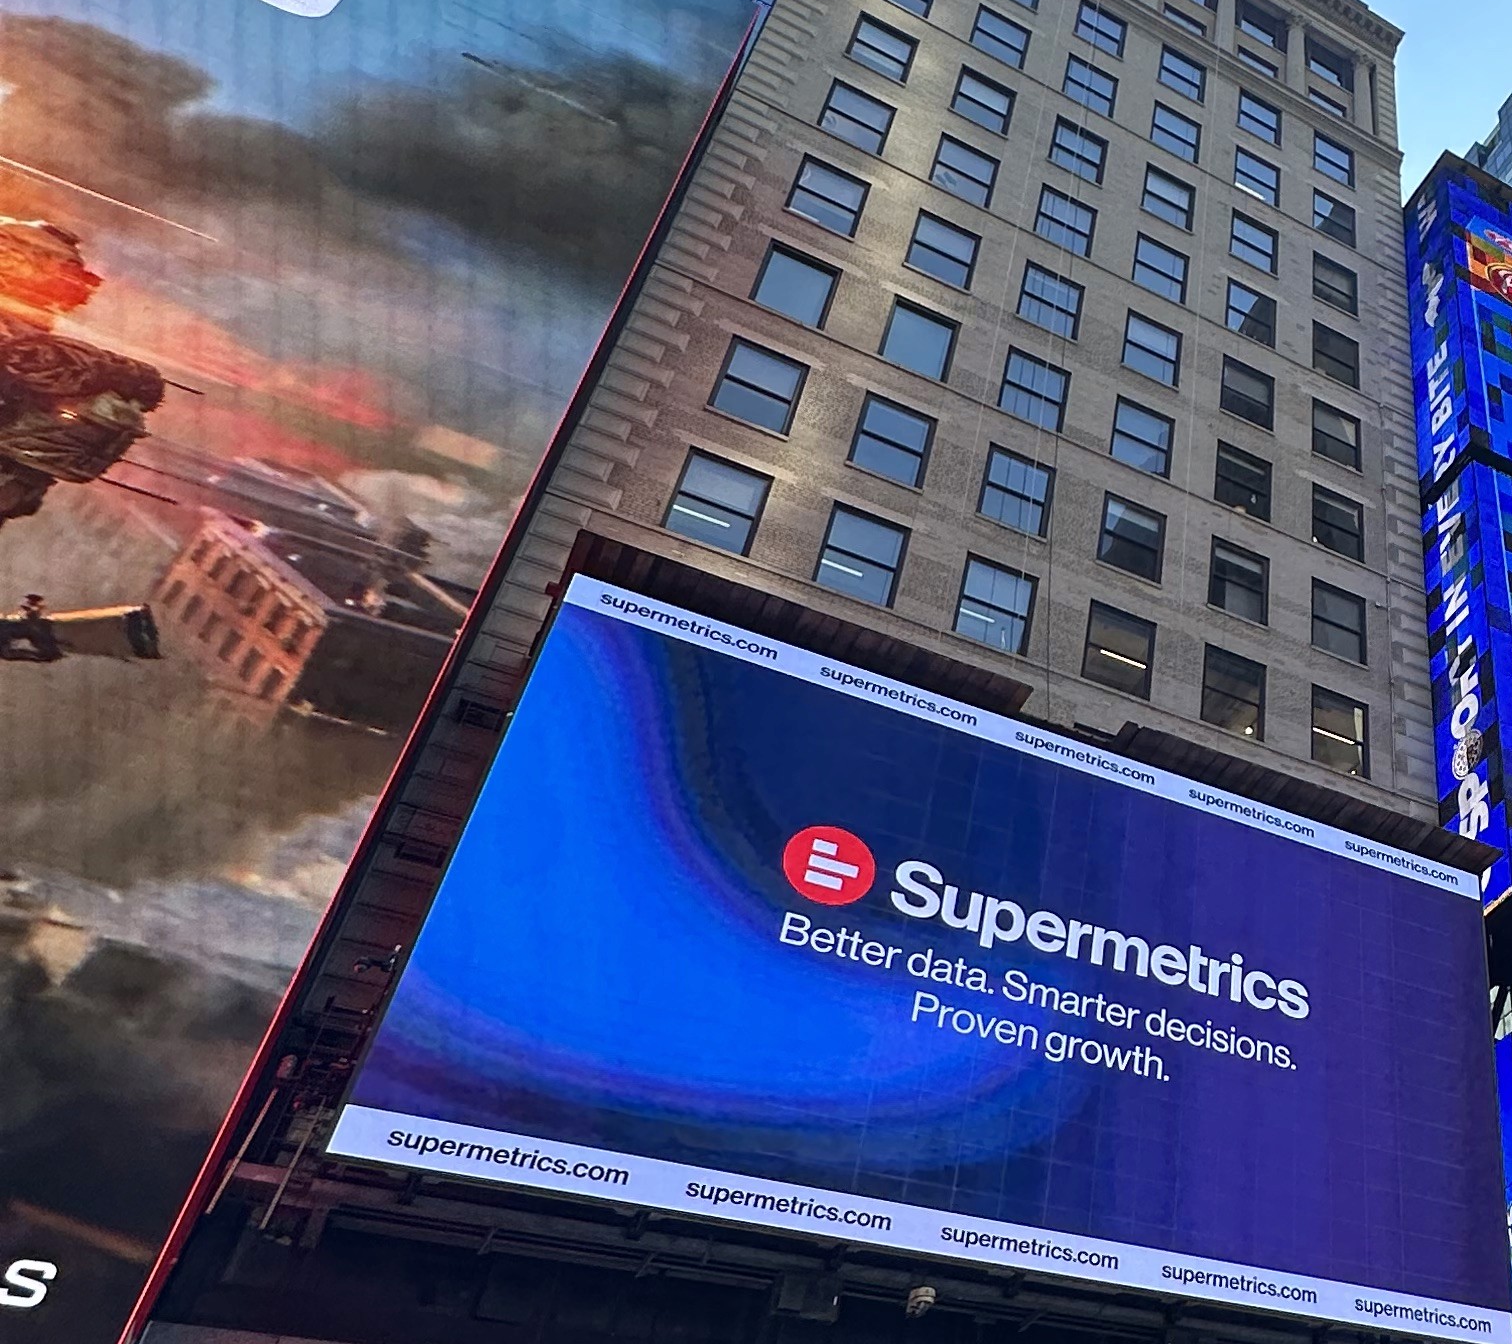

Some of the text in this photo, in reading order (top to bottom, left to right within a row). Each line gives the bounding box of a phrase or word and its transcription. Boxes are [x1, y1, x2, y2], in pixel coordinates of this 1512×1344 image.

[1426, 340, 1453, 432] BITE
[599, 590, 779, 662] supermetrics.com
[819, 663, 979, 728] supermetrics.com
[1014, 728, 1156, 786] supermetrics.com
[1188, 786, 1316, 839] supermetrics.com
[1343, 837, 1460, 887] supermetrics.com
[778, 911, 1298, 1071] Better data. Smarter decisions.
[890, 859, 1311, 1020] Supermetrics
[910, 991, 1171, 1083] Proven growth.
[386, 1127, 1493, 1335] supermetrics.com supermetrics.com supermetrics.com supermetrics.com supermetrics.com
